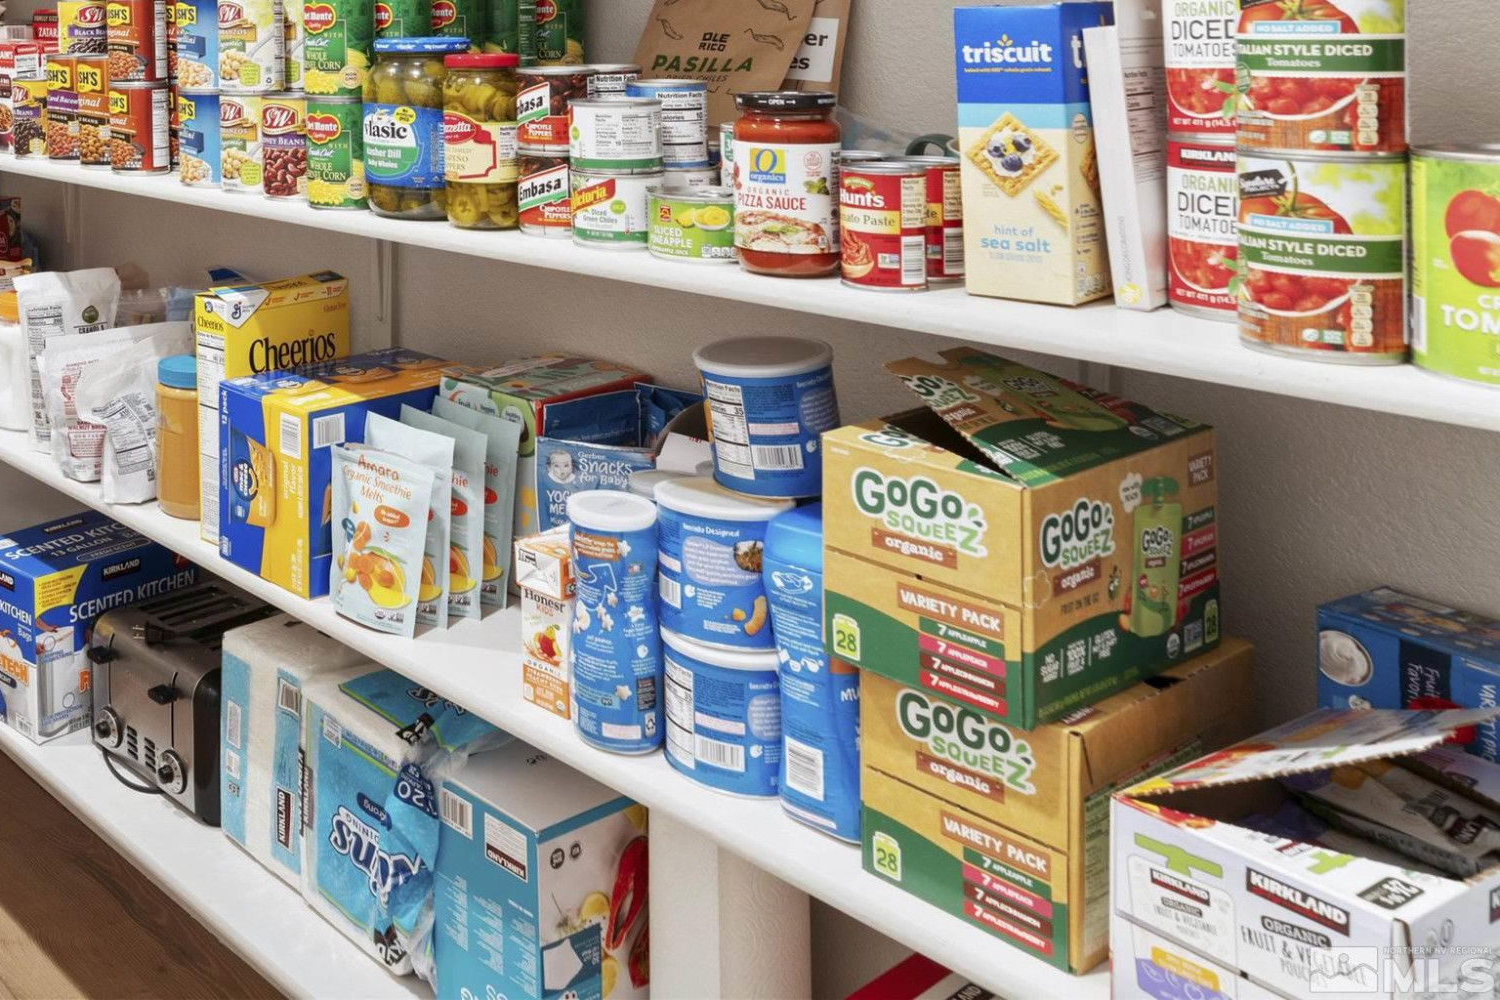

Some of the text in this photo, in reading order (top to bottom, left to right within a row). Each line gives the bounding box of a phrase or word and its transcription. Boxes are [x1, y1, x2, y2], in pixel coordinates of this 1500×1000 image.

[1174, 1, 1234, 17] ORGANIC
[703, 33, 730, 42] OLE
[1172, 19, 1235, 39] DICED
[306, 51, 327, 61] WHOLE
[698, 42, 726, 51] RICO
[962, 41, 1052, 63] triscuit
[1172, 43, 1237, 57] TOMATOES
[318, 60, 341, 69] CORN
[651, 55, 753, 72] PASILLA
[1266, 58, 1321, 68] Tomatoes
[364, 120, 407, 139] vlasic
[525, 122, 552, 131] CHIPOTLE
[1181, 150, 1237, 163] KIRKLAN
[310, 162, 332, 171] WHOLE
[323, 169, 346, 180] CORN
[750, 173, 786, 182] organics
[519, 180, 562, 201] Embasa
[840, 189, 885, 208] Hunt's
[738, 193, 806, 210] PIZZA SAUCE
[654, 227, 683, 236] SLICED
[994, 225, 1034, 237] hint of
[981, 237, 1051, 252] sea salt
[1261, 251, 1314, 267] Tomatoes
[197, 316, 224, 331] Cheerios
[249, 329, 336, 373] Cheerios
[358, 454, 399, 481] Amara
[579, 459, 633, 475] Snacks
[1189, 456, 1212, 473] VARIETY
[343, 465, 412, 500] Organic Smoothie
[579, 475, 629, 489] for Baby
[360, 486, 384, 503] Melts
[854, 470, 963, 520] GoGo
[5, 522, 128, 560] SCENTED KITC
[886, 510, 979, 553] SQUEEZ
[1043, 502, 1102, 564] GoGo
[50, 536, 112, 558] 13 GALLON
[885, 536, 943, 562] organic
[1062, 529, 1111, 566] SQUEEZ
[103, 558, 140, 576] KIRKLAND
[1061, 566, 1095, 589] organic
[69, 589, 134, 623] SCENTED
[137, 569, 195, 598] KITCHEN
[524, 588, 565, 613] Honest
[0, 600, 32, 626] KITCHEN
[536, 604, 553, 617] KIDS
[900, 589, 1000, 632] VARIETY PACK
[18, 628, 33, 642] Bags
[837, 629, 857, 652] 28
[899, 693, 1011, 753] GoGo
[932, 736, 1027, 790] SQUEEZ
[930, 762, 990, 794] organic
[278, 790, 286, 843] KIRKLAND
[943, 817, 1047, 873] VARIETY PACK
[877, 849, 898, 872] 28
[1152, 872, 1209, 901] KIRKLAND
[1250, 871, 1347, 925] KIRKLAND
[1264, 918, 1328, 947] ORGANIC
